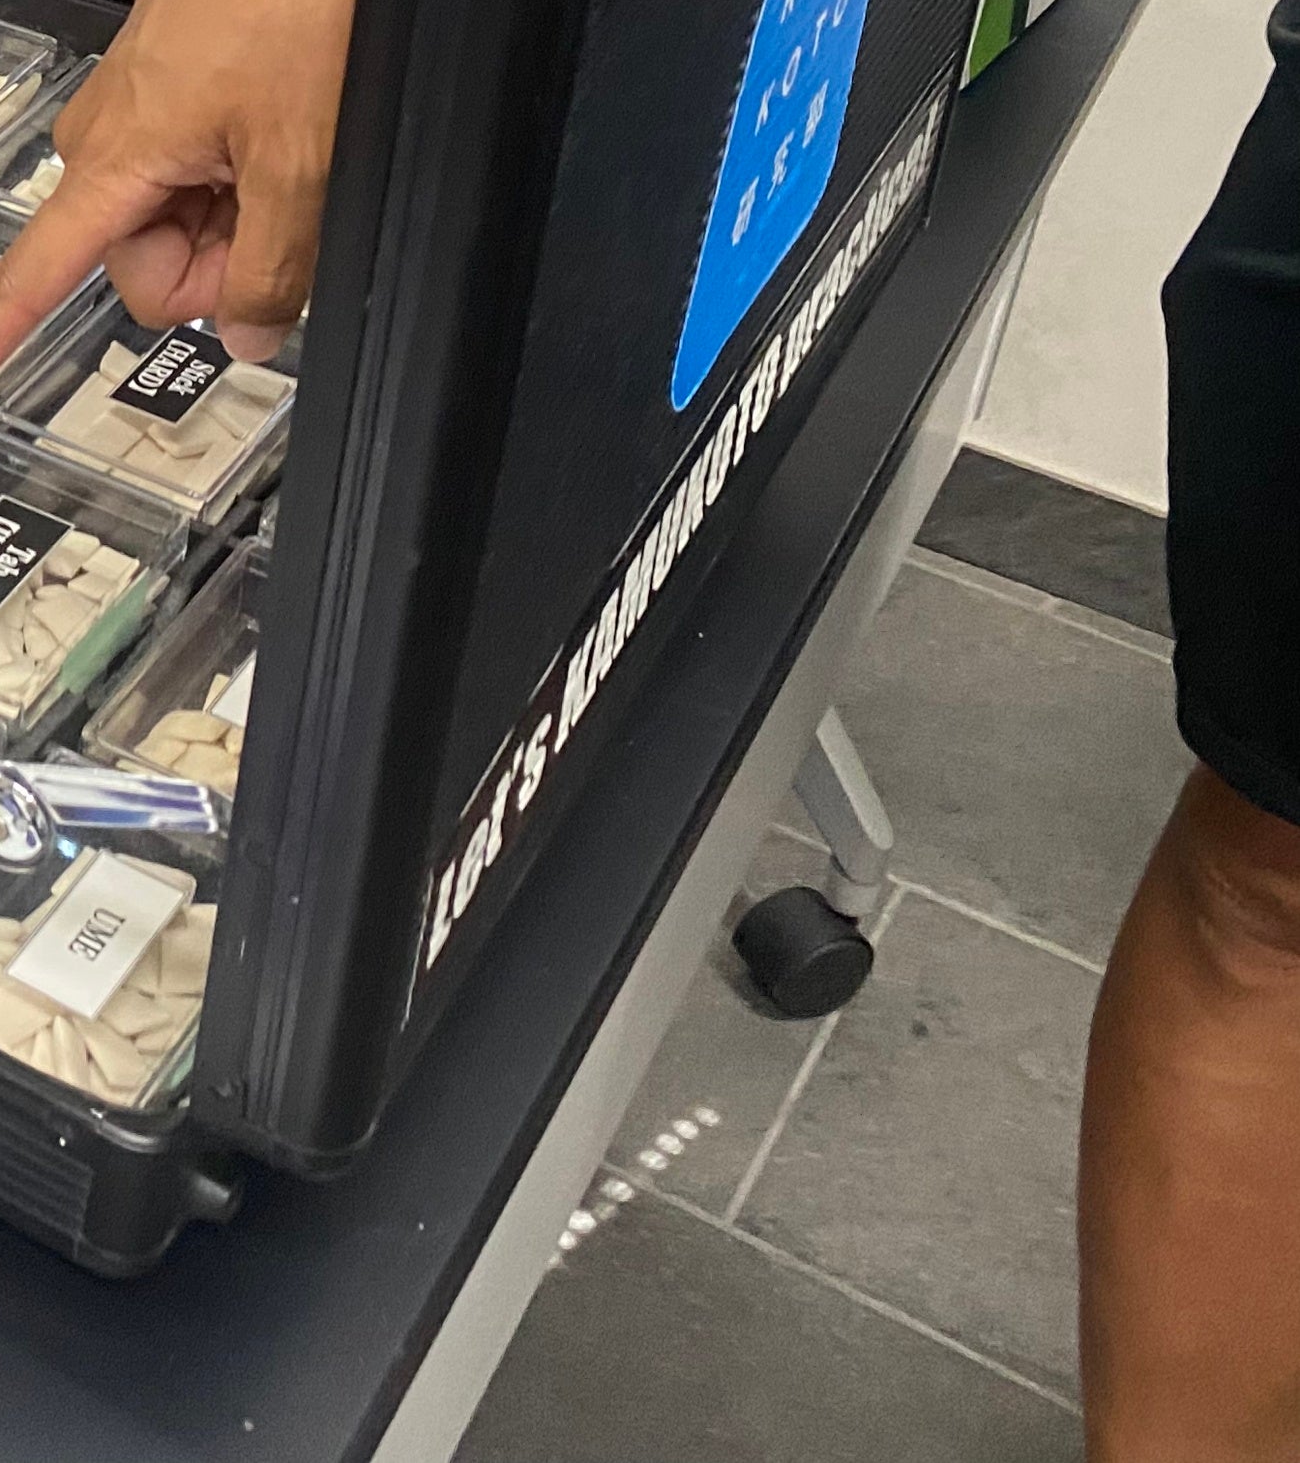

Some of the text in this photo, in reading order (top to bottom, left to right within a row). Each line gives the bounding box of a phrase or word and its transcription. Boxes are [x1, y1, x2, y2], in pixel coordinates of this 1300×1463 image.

[167, 358, 216, 396] Stick
[426, 713, 552, 970] Let's
[554, 333, 782, 754] KAMUKOTO
[68, 907, 126, 962] UME
